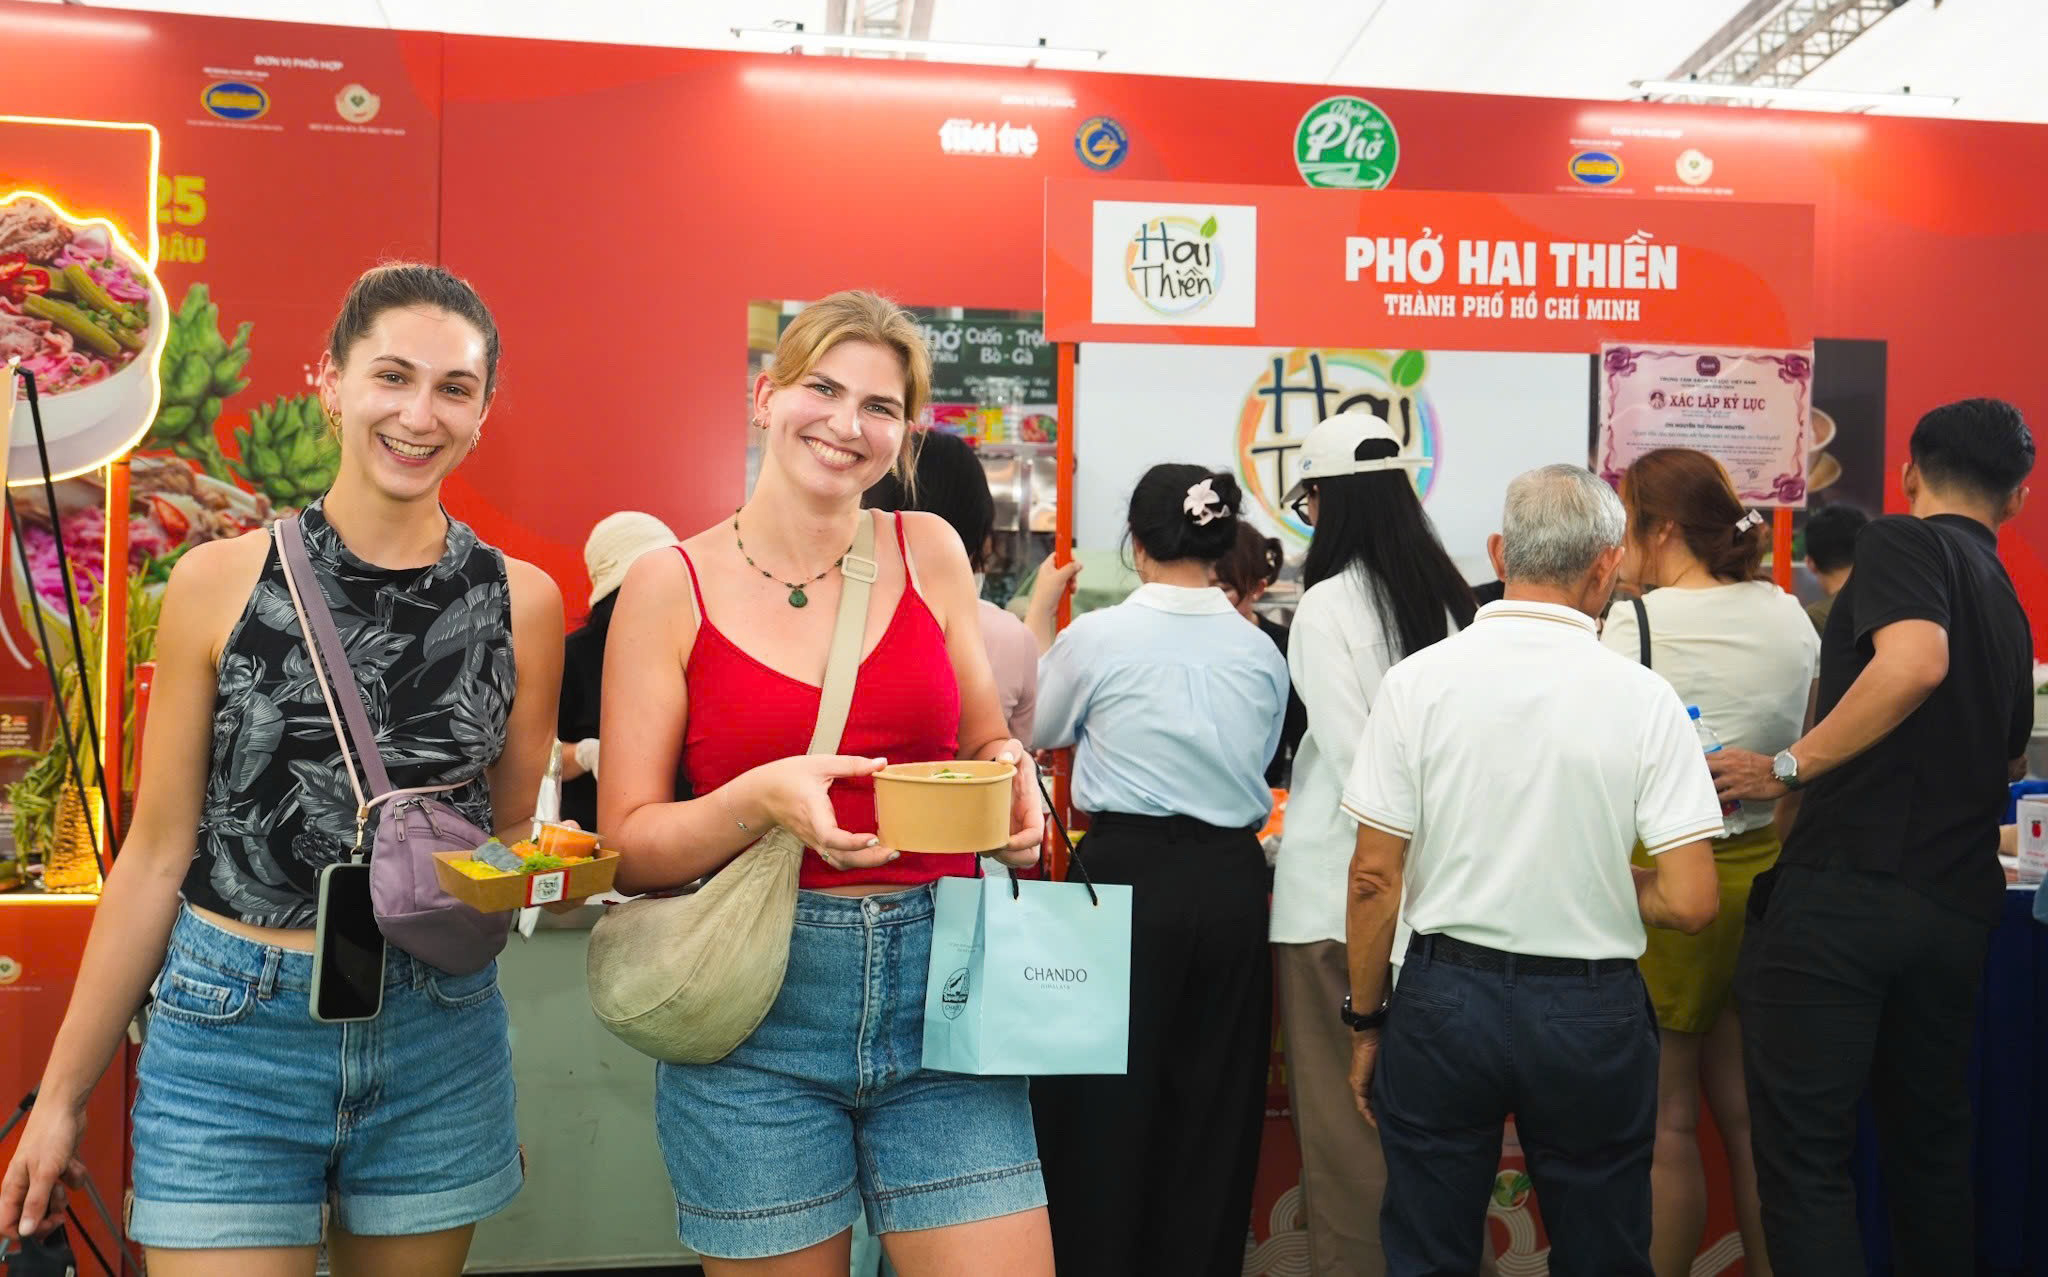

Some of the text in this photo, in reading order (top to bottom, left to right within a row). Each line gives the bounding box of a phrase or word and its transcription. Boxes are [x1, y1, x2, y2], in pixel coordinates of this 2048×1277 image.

[1304, 112, 1386, 161] Phở
[1135, 221, 1211, 267] Hai
[1345, 227, 1678, 290] PHỞ HAI THIỀN
[1131, 263, 1212, 299] Thiền
[1384, 290, 1641, 321] THÀNH PHỐ HỒ CHÍ MINH
[922, 322, 963, 352] hở
[965, 325, 1003, 345] Cuốn
[980, 346, 1002, 364] Bò
[1011, 347, 1034, 366] Gà
[1669, 393, 1694, 407] XÁC
[1698, 393, 1720, 411] LẬP
[1743, 398, 1766, 413] LỤC
[1023, 966, 1088, 983] CHANDO
